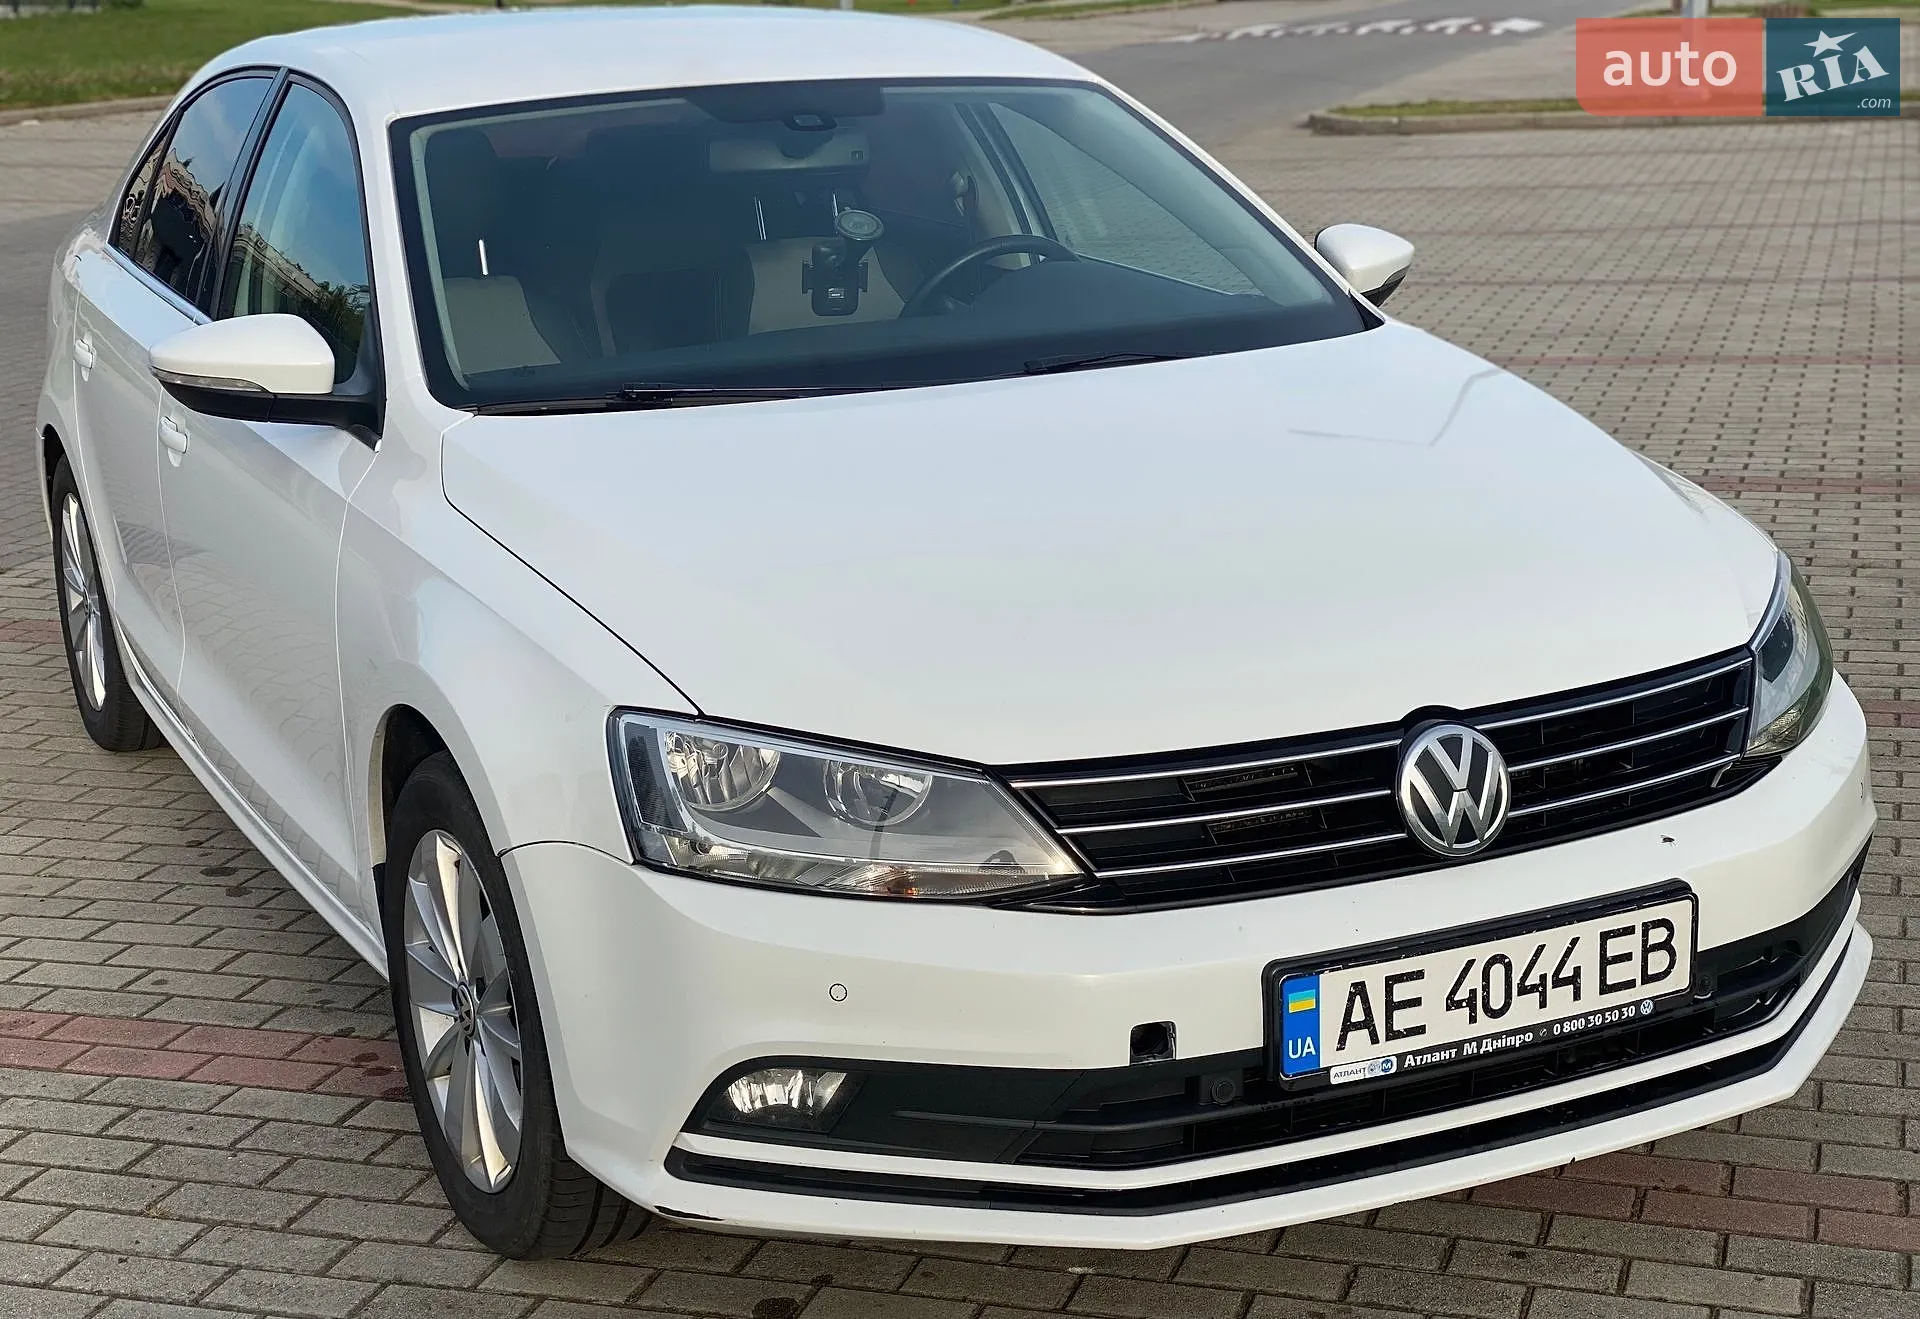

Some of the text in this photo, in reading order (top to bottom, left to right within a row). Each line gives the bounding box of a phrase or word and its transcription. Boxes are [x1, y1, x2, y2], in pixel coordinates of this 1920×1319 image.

[1335, 917, 1678, 1052] AE 4044 EB
[1288, 1036, 1316, 1059] UA
[1404, 1005, 1636, 1068] Атлант М Дніпро 0 800 30 50 30
[1333, 1067, 1366, 1079] АТЛАНТ
